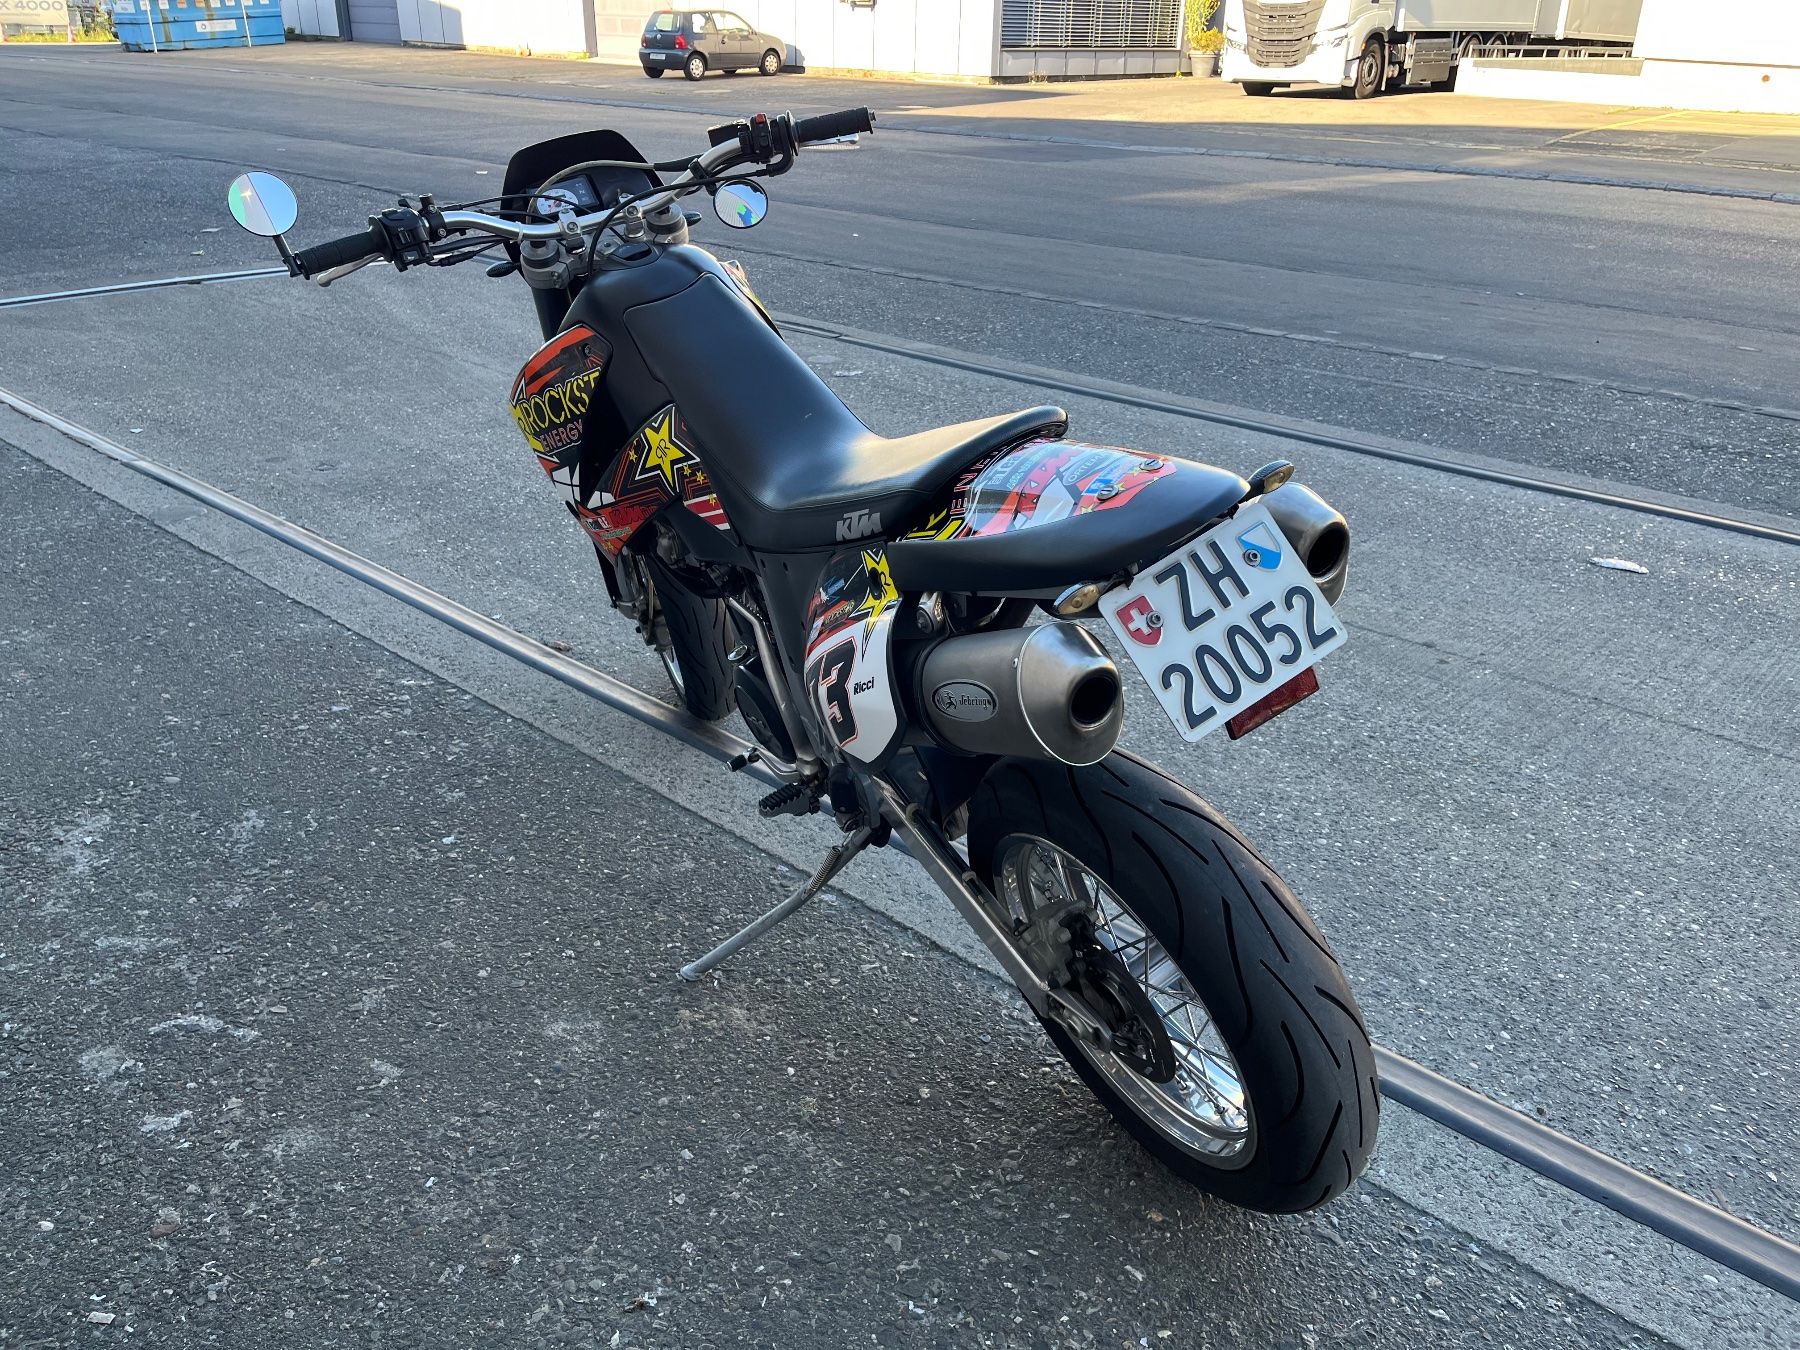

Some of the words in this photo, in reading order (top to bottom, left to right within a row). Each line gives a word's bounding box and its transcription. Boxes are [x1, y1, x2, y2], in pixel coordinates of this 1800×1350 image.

[15, 0, 63, 11] 4000
[835, 508, 882, 542] KTM
[1154, 539, 1250, 632] ZH
[1161, 585, 1337, 730] 20052
[853, 676, 875, 696] Ricci
